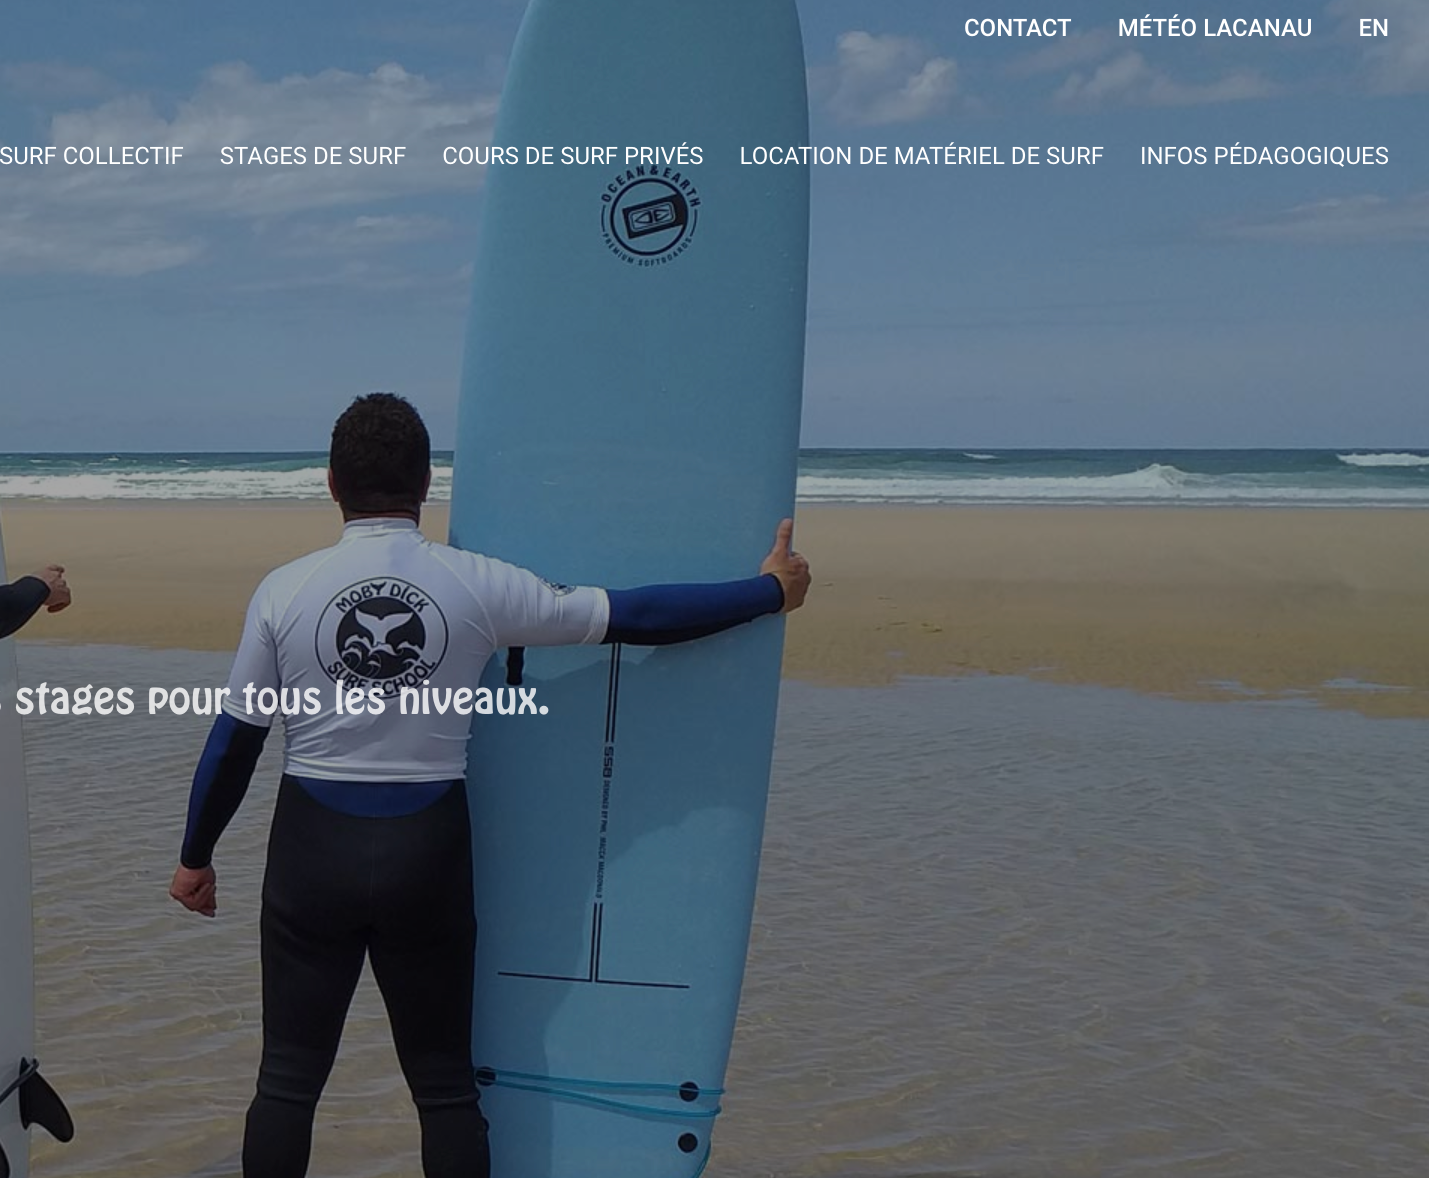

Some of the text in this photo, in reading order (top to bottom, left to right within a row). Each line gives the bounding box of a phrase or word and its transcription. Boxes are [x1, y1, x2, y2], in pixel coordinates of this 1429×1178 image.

[601, 165, 701, 207] OCEAN & EARTH
[335, 581, 429, 613] MOBY DICK
